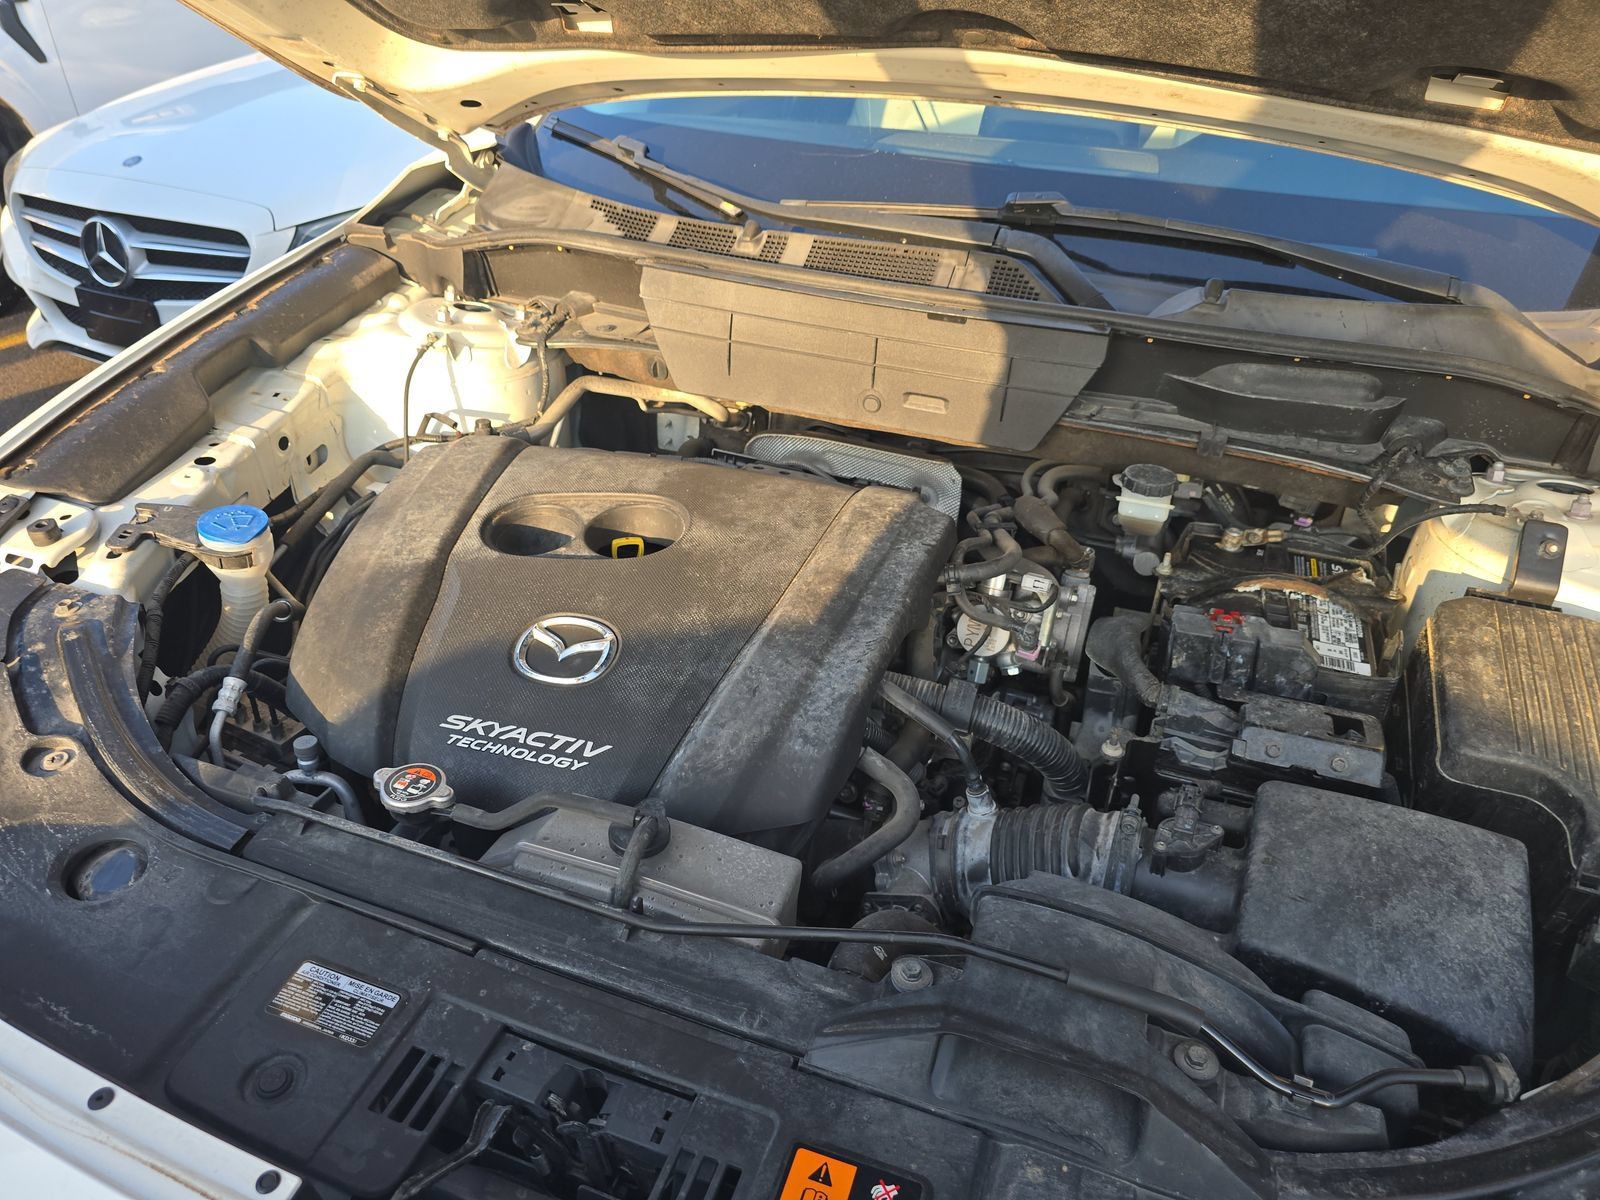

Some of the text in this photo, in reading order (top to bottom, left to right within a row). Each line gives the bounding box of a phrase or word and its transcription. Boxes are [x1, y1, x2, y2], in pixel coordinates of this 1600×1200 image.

[439, 715, 613, 758] SKYACTIV
[446, 734, 589, 771] TECHNOLOGY
[309, 966, 341, 981] CAUTION
[348, 980, 399, 1002] MISE EN GARDE
